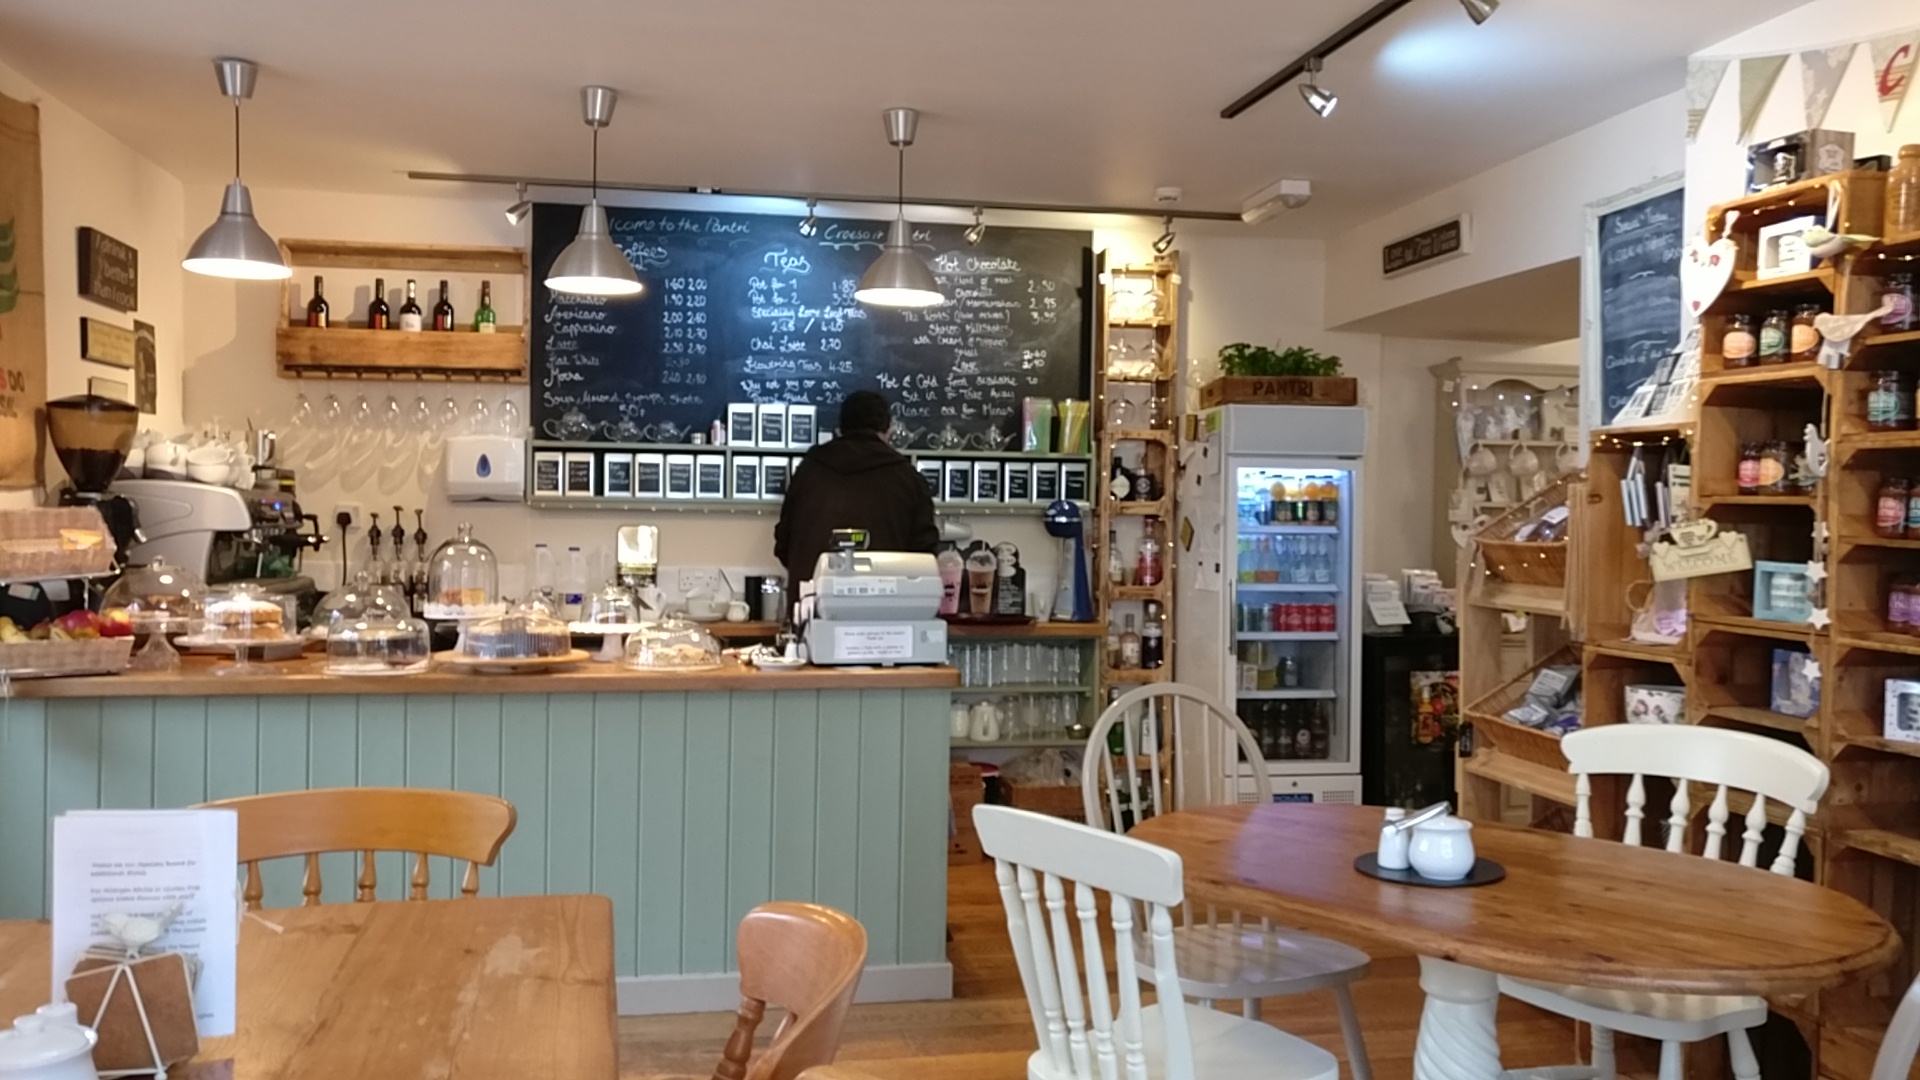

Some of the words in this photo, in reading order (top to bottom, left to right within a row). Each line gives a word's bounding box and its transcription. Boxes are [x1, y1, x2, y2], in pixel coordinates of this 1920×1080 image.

[610, 217, 655, 231] lcome
[658, 216, 675, 231] to
[677, 217, 700, 232] the
[705, 217, 750, 233] Pantri
[824, 224, 870, 240] Croeso
[764, 248, 812, 273] Teas
[934, 254, 960, 271] Hot
[966, 256, 1021, 271] Chocolate
[791, 292, 800, 304] 2
[916, 373, 939, 387] Cold
[1252, 381, 1313, 398] PANTRI
[1662, 551, 1739, 572] WELCOME
